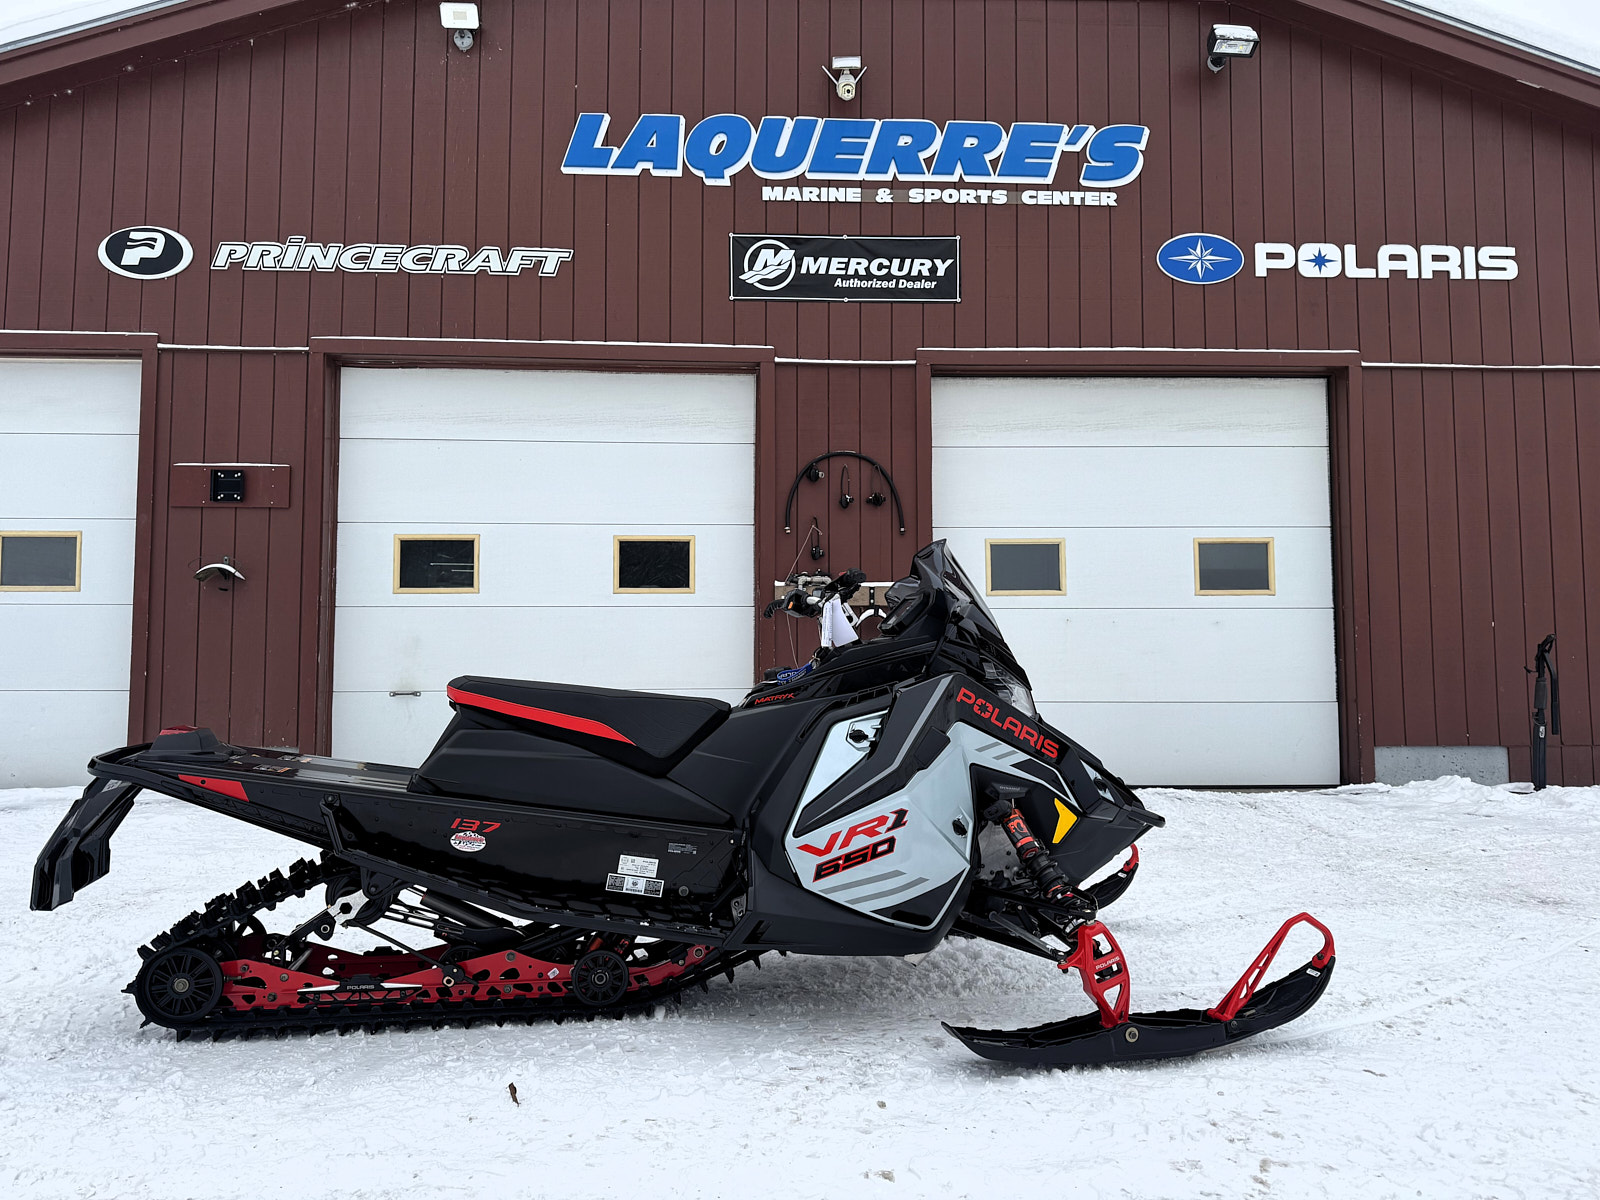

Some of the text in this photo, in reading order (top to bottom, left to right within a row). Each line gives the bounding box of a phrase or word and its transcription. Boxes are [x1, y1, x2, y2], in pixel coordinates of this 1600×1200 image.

[561, 112, 1150, 187] LAQUERRE'S
[762, 186, 1118, 206] MARINE & SPORTS CENTER
[800, 256, 954, 277] MERCURY
[1254, 242, 1519, 280] POLARIS
[834, 277, 937, 289] Authorized Dealer
[754, 692, 795, 705] MATRYX
[956, 687, 1060, 760] POLARIS
[450, 817, 502, 833] 137
[796, 808, 909, 857] VR1
[812, 835, 897, 883] 650
[1095, 955, 1121, 970] POLARIS
